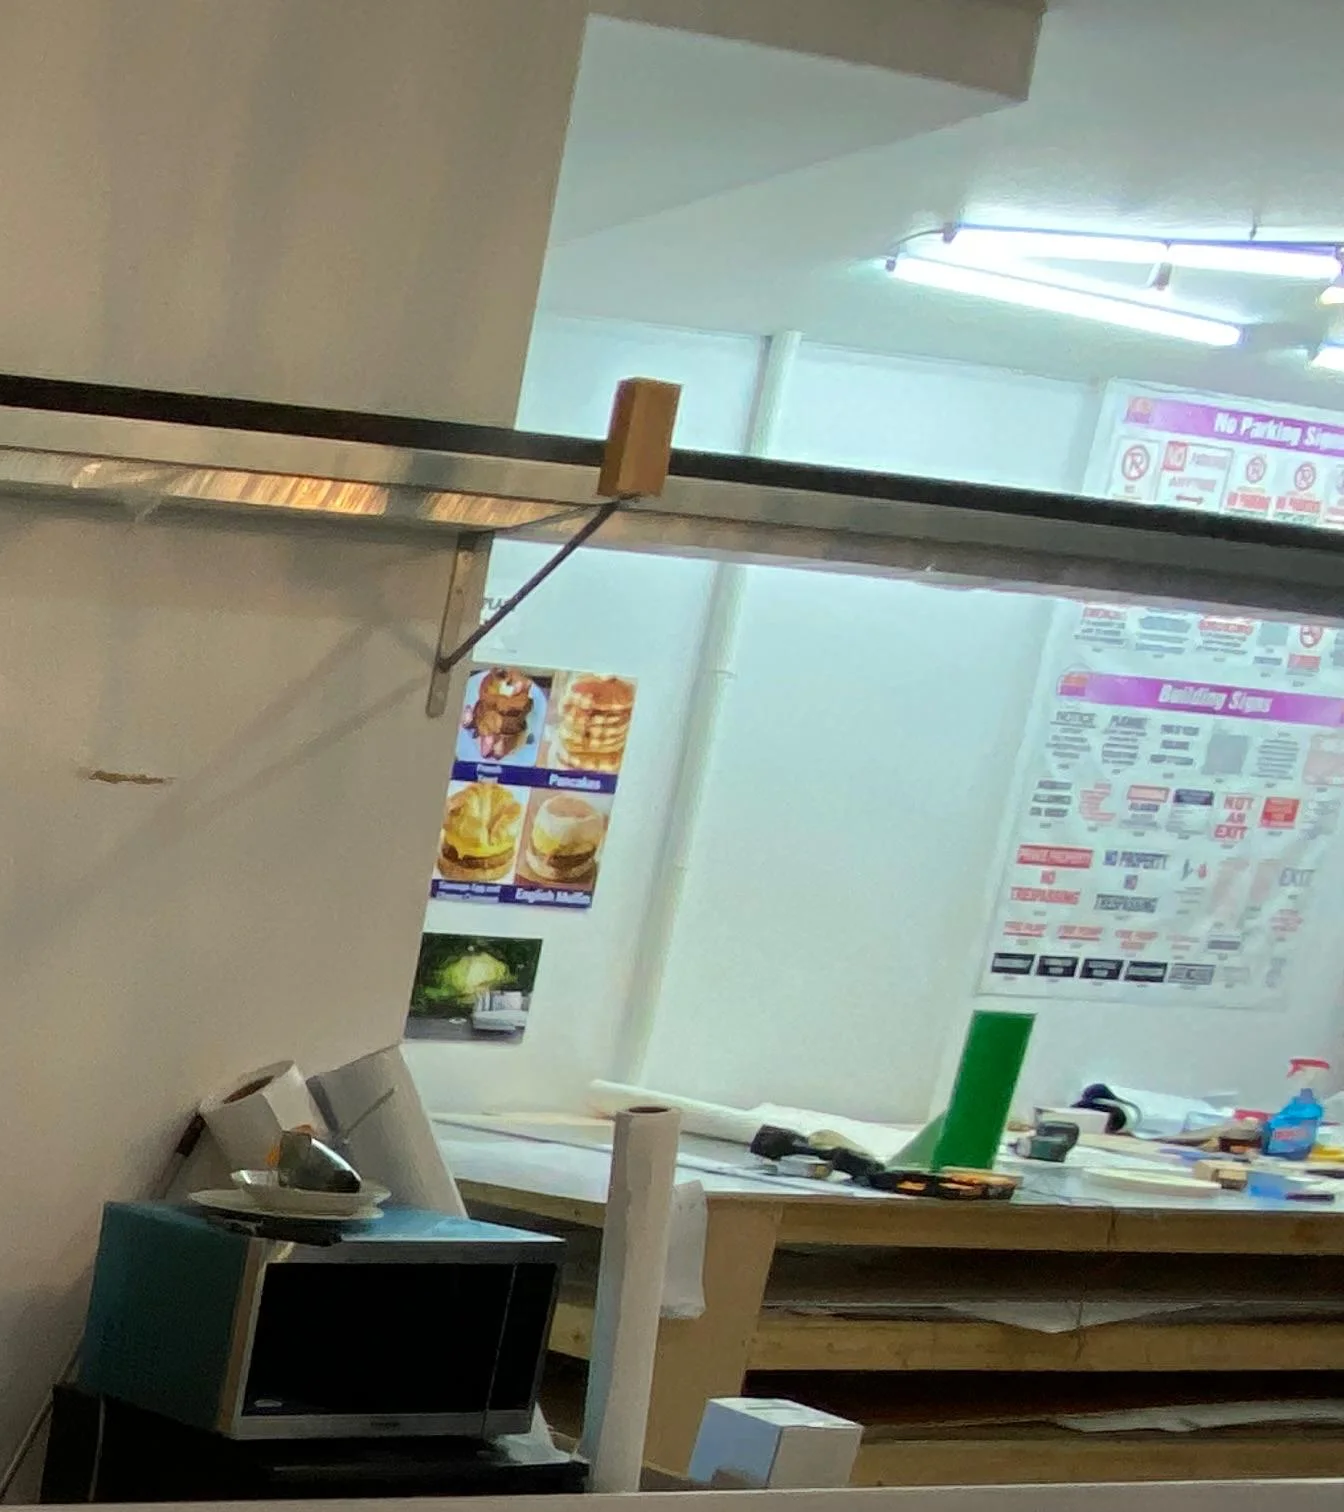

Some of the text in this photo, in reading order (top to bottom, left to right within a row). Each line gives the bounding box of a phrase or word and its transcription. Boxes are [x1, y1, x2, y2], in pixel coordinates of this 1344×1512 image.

[1214, 412, 1238, 434] No
[1240, 416, 1303, 446] Parking
[1157, 684, 1274, 714] Building Signs
